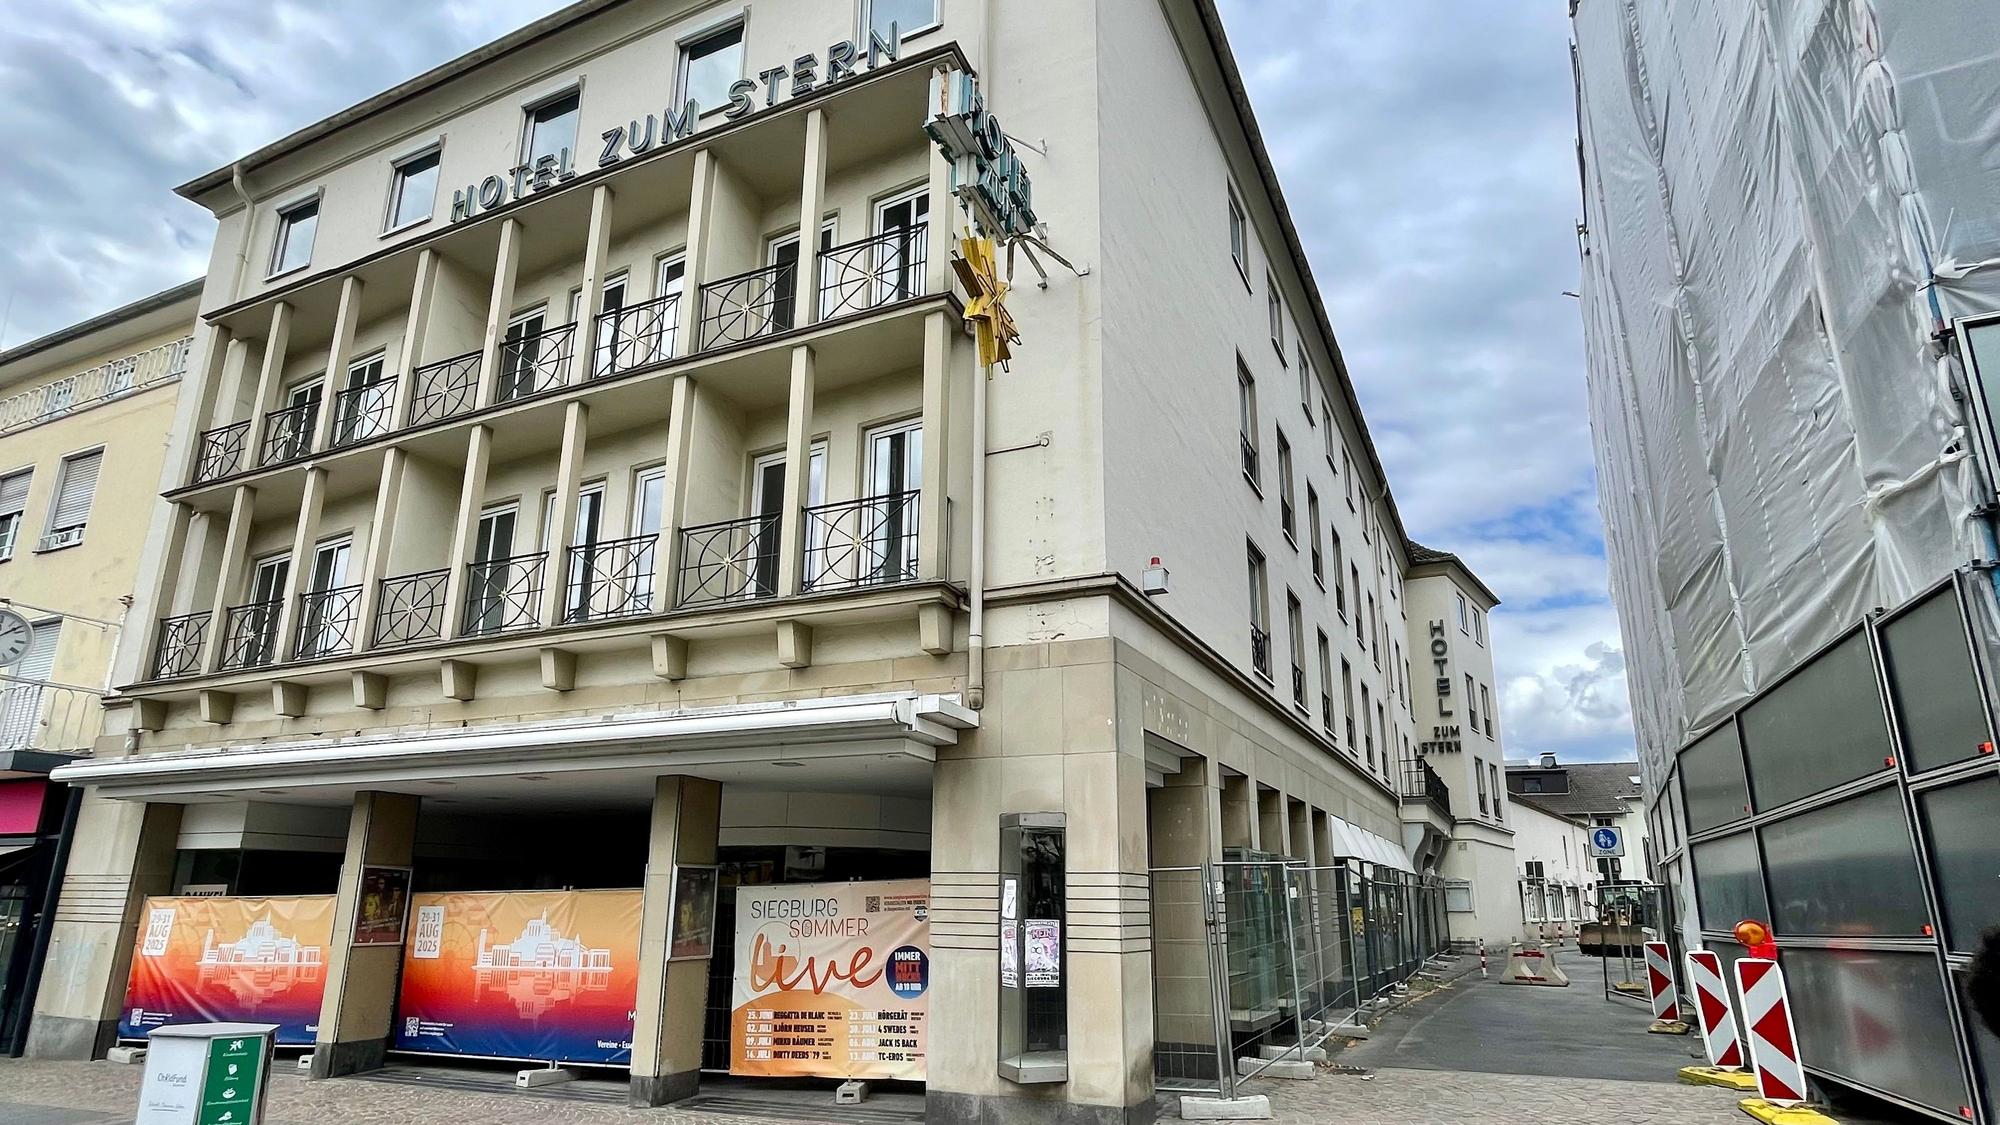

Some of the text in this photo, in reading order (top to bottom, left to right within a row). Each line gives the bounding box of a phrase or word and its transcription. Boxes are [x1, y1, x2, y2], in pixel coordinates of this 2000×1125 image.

[450, 20, 899, 223] HOTEL ZUM STERN
[1429, 619, 1453, 718] HOTEL
[1433, 725, 1460, 739] ZUM
[1421, 741, 1461, 754] STERN
[751, 898, 838, 919] SIEGBURG
[149, 925, 169, 938] AUG
[418, 924, 440, 938] AUG
[789, 917, 869, 938] SOMMER
[145, 939, 165, 951] 2025
[417, 940, 438, 952] 2025
[895, 951, 920, 961] IMMER
[750, 933, 883, 995] live
[877, 1009, 908, 1020] HÖRGERÄT
[883, 1025, 907, 1033] SWEDES
[878, 1039, 893, 1047] JACK
[895, 1039, 900, 1047] IS
[901, 1039, 918, 1048] BACK
[878, 1052, 904, 1061] TC-EROS
